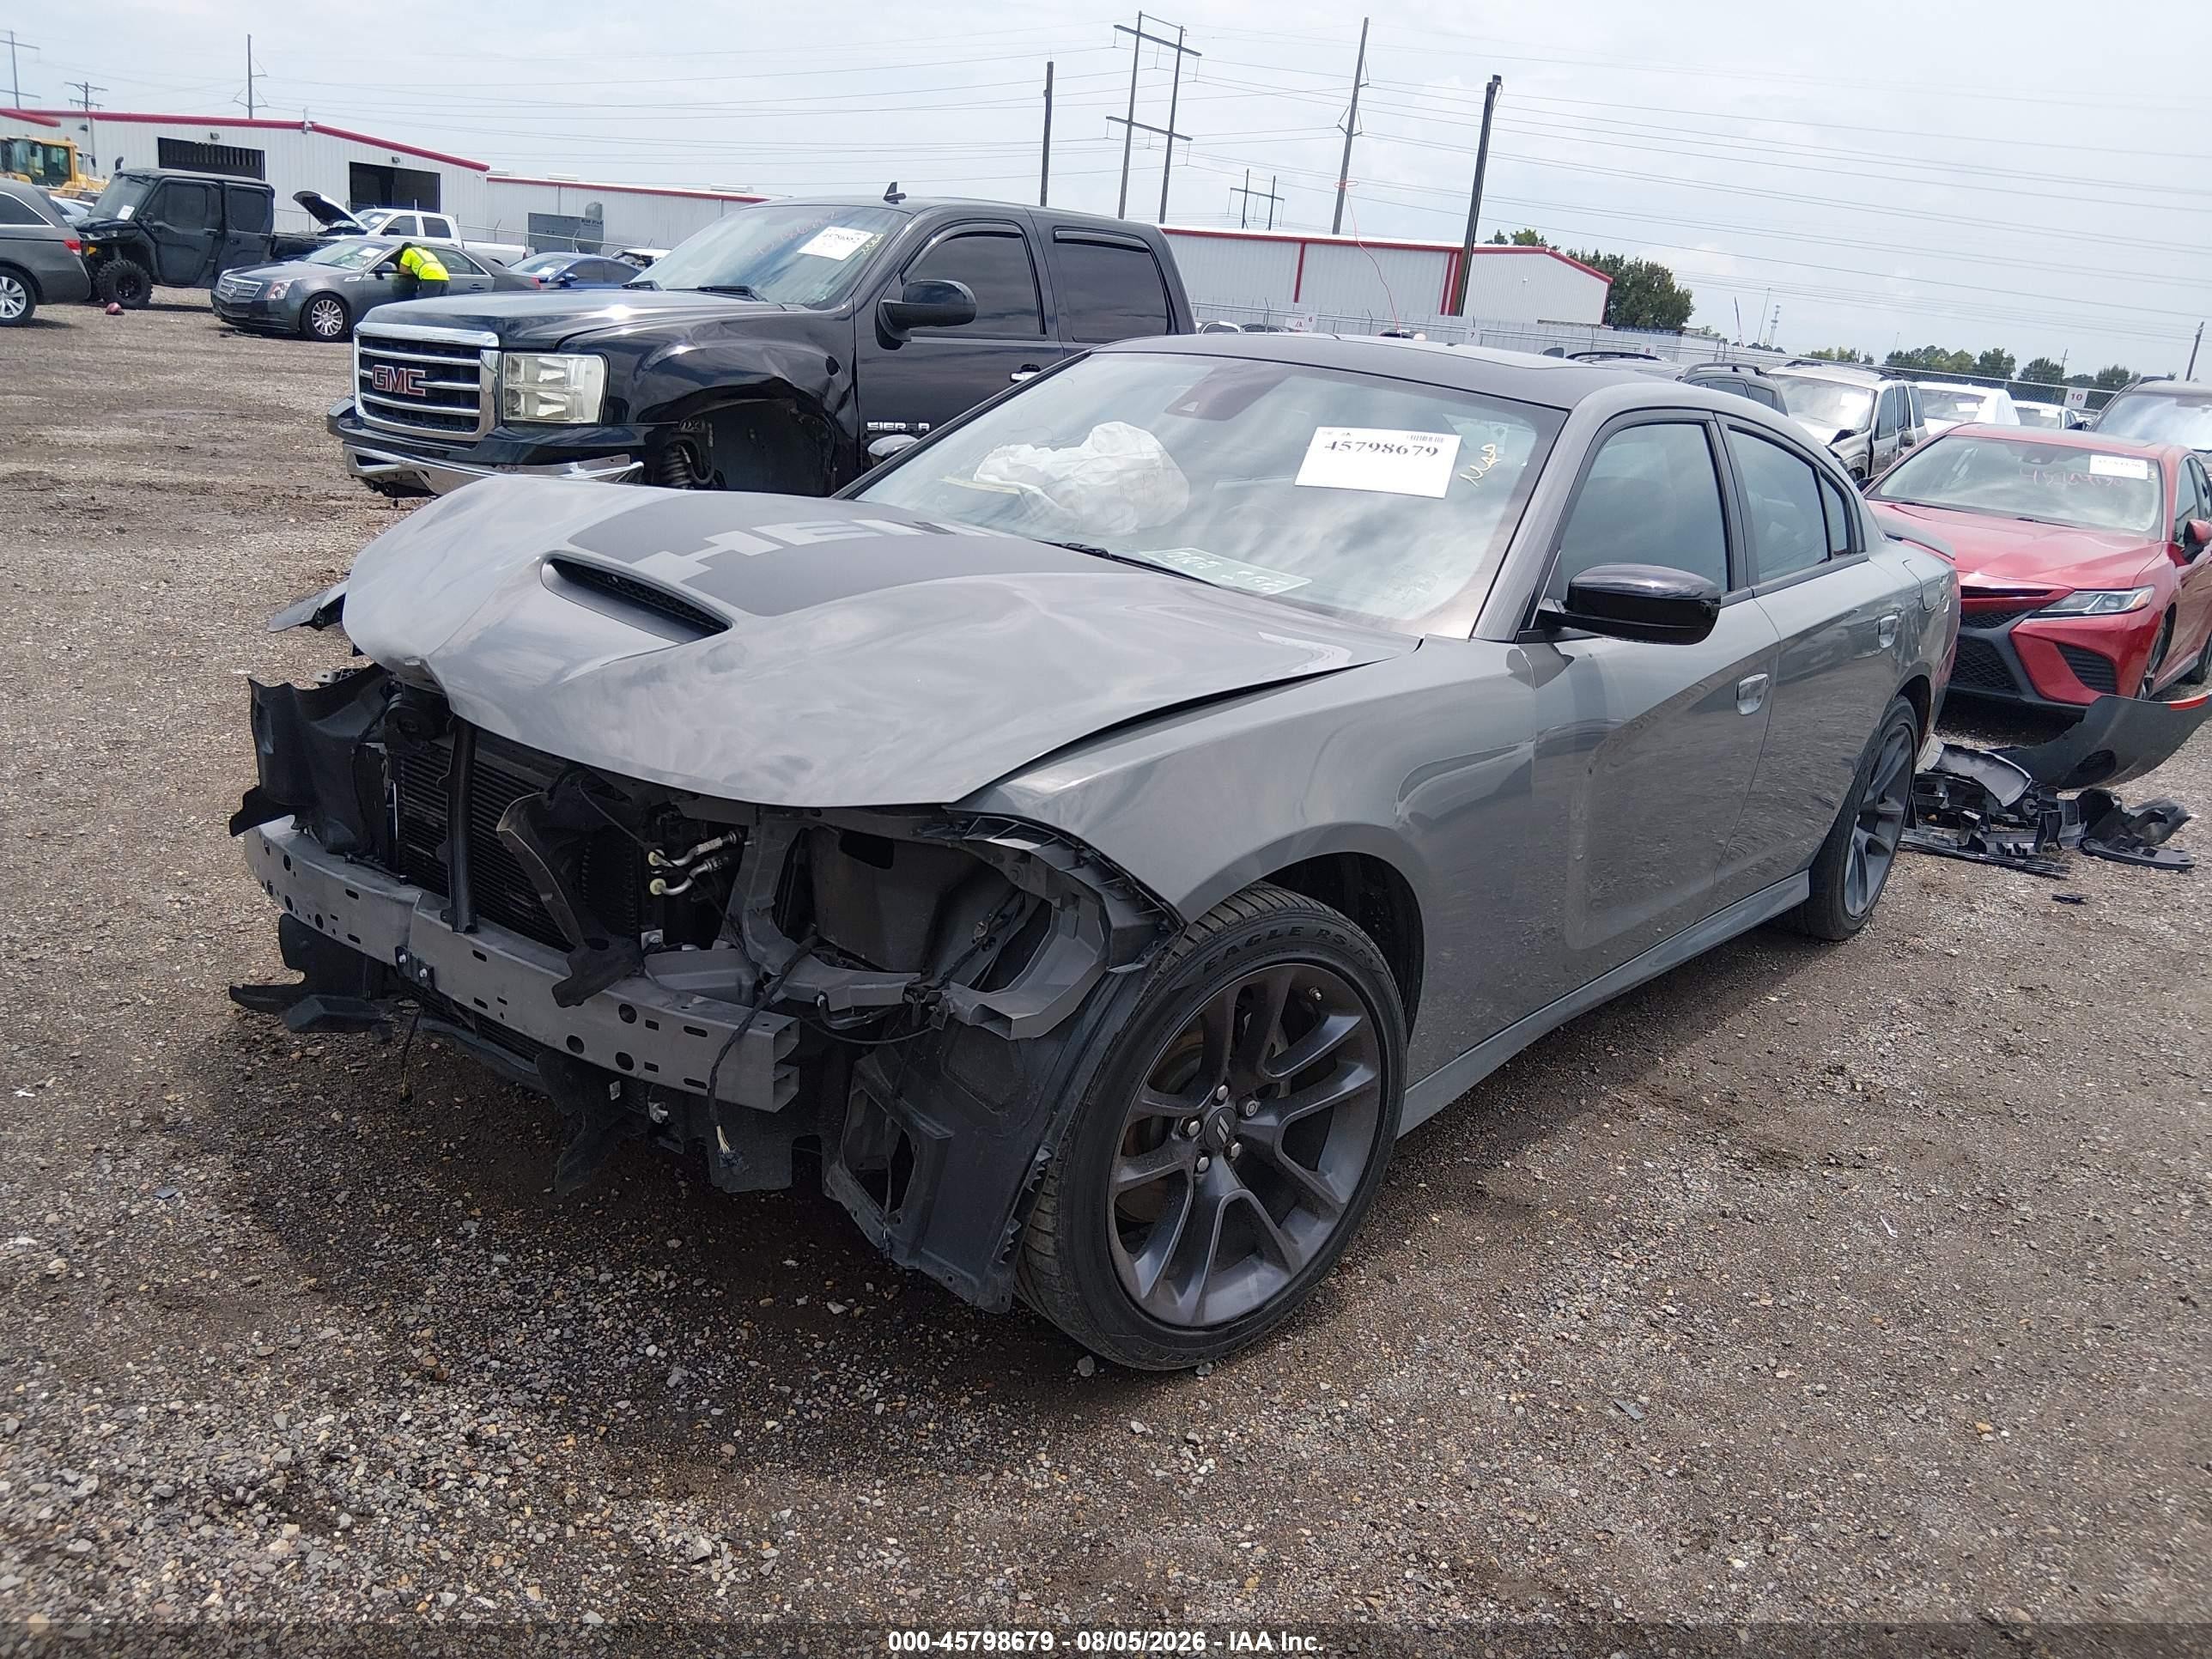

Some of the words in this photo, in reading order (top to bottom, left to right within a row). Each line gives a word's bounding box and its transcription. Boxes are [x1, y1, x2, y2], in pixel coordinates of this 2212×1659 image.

[372, 364, 427, 397] GMC
[2070, 393, 2083, 402] 10
[866, 422, 930, 432] SIERRA
[1323, 439, 1439, 458] 45798679
[1203, 926, 1304, 971] EAGLE
